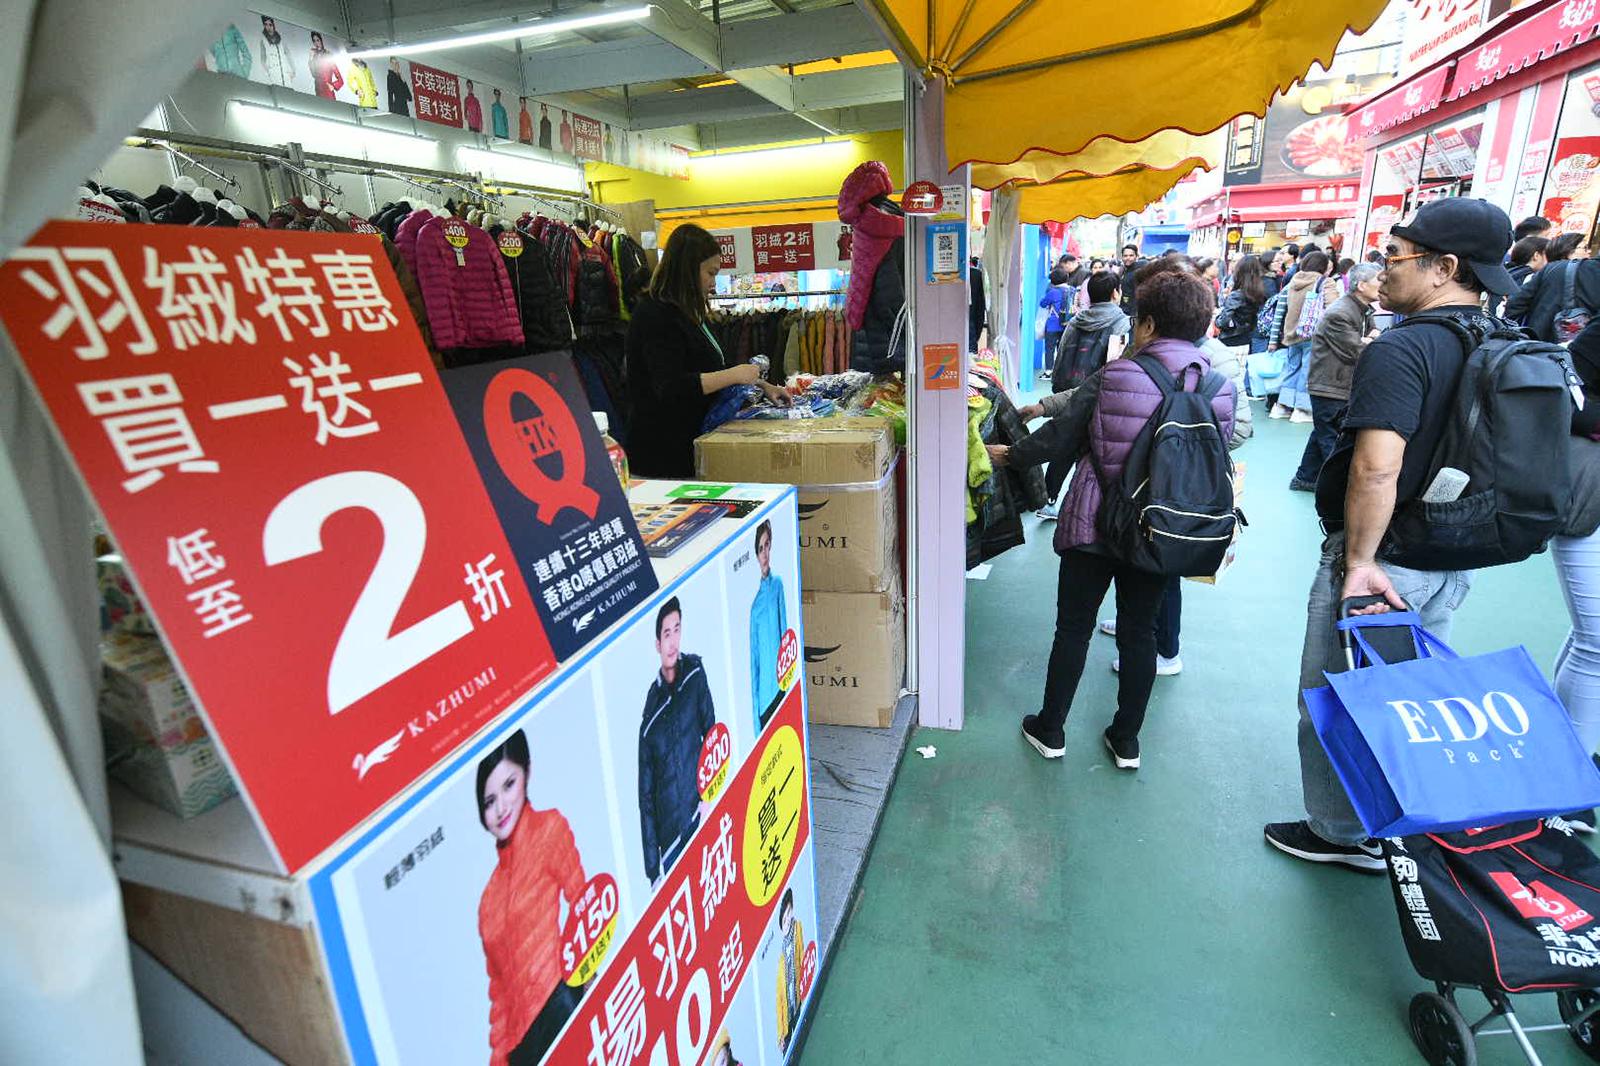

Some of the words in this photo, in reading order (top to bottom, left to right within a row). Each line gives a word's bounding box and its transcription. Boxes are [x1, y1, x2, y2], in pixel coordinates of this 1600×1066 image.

[413, 67, 457, 98] 女裝羽絨
[418, 95, 458, 120] 買1送1
[754, 231, 811, 248] 羽絨2折
[756, 248, 812, 266] 買一送一
[8, 243, 400, 361] 羽絨特惠
[76, 351, 424, 494] 買一送一
[532, 516, 627, 584] 連續十三年榮獲
[166, 528, 254, 639] 低至
[262, 470, 475, 716] 2
[464, 553, 515, 622] 折
[598, 580, 637, 614] KAZHUMI
[777, 638, 797, 680] $230
[407, 666, 497, 737] KAZHUMI
[1385, 691, 1530, 743] EDO
[698, 732, 729, 790] $300
[1442, 743, 1524, 764] Pack
[562, 883, 616, 972] $150
